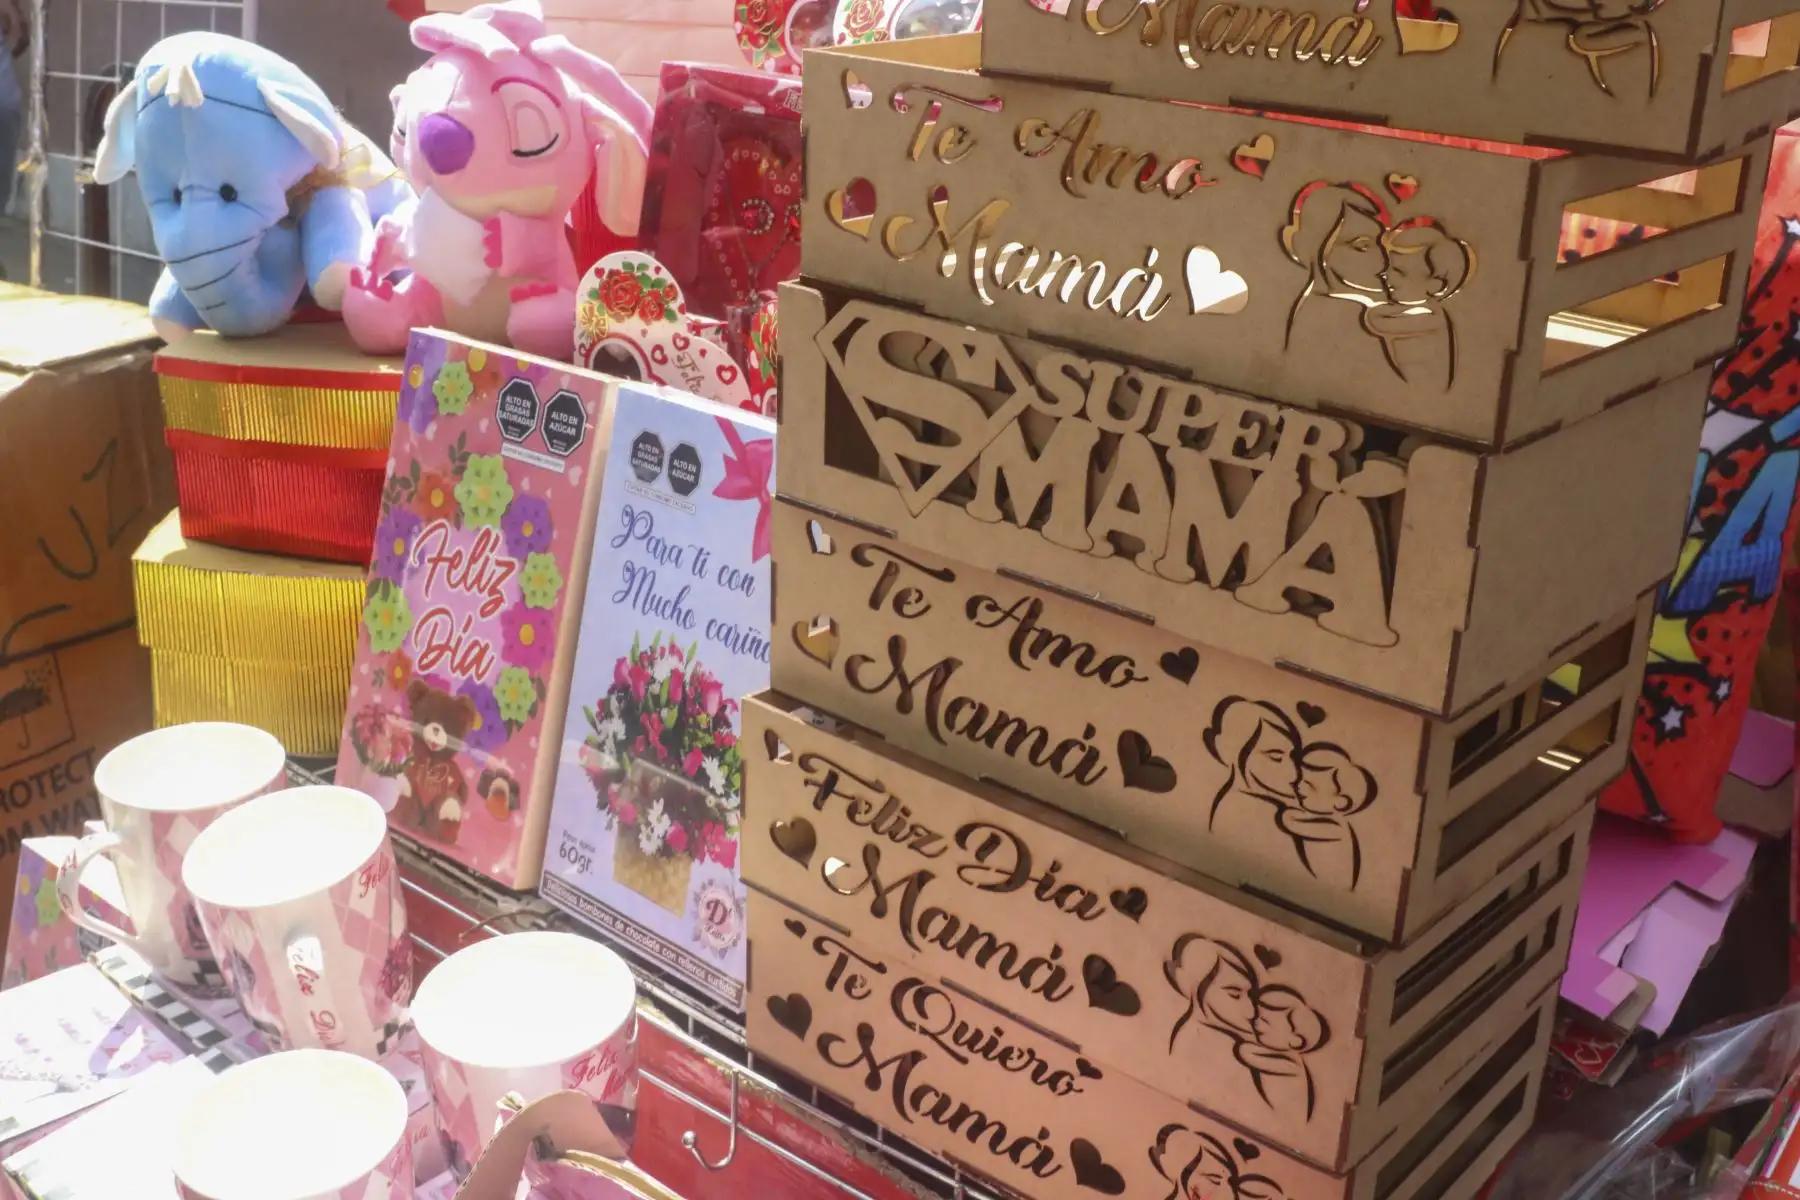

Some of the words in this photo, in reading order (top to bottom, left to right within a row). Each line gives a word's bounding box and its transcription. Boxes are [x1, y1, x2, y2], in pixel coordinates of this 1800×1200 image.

[890, 84, 1002, 165] Te
[1015, 107, 1218, 199] Amo
[881, 184, 1174, 322] Mamá
[505, 403, 530, 417] GRASAS
[506, 395, 521, 406] ALTO
[521, 399, 531, 409] EN
[551, 411, 567, 422] ALTO
[568, 415, 578, 425] EN
[638, 443, 651, 451] ALTO
[651, 447, 659, 455] EN
[1034, 352, 1348, 493] SUPER
[673, 459, 687, 470] ALTO
[687, 464, 697, 473] EN
[413, 520, 517, 620] Feliz
[610, 504, 684, 569] Para
[687, 543, 711, 580] ti
[717, 564, 755, 598] con
[611, 559, 697, 630] Mucho
[413, 606, 496, 683] Día
[850, 542, 957, 620] Te
[965, 593, 1149, 689] Amo
[844, 633, 1108, 787] Mamá
[798, 751, 948, 860] Feliz
[579, 896, 614, 928] bombones
[614, 918, 625, 932] de
[625, 925, 661, 953] chocolate
[661, 946, 677, 961] con
[820, 843, 1074, 1004] Mamá
[812, 934, 888, 1001] Te
[890, 976, 1086, 1099] Quiero
[815, 1021, 1063, 1180] Mamá
